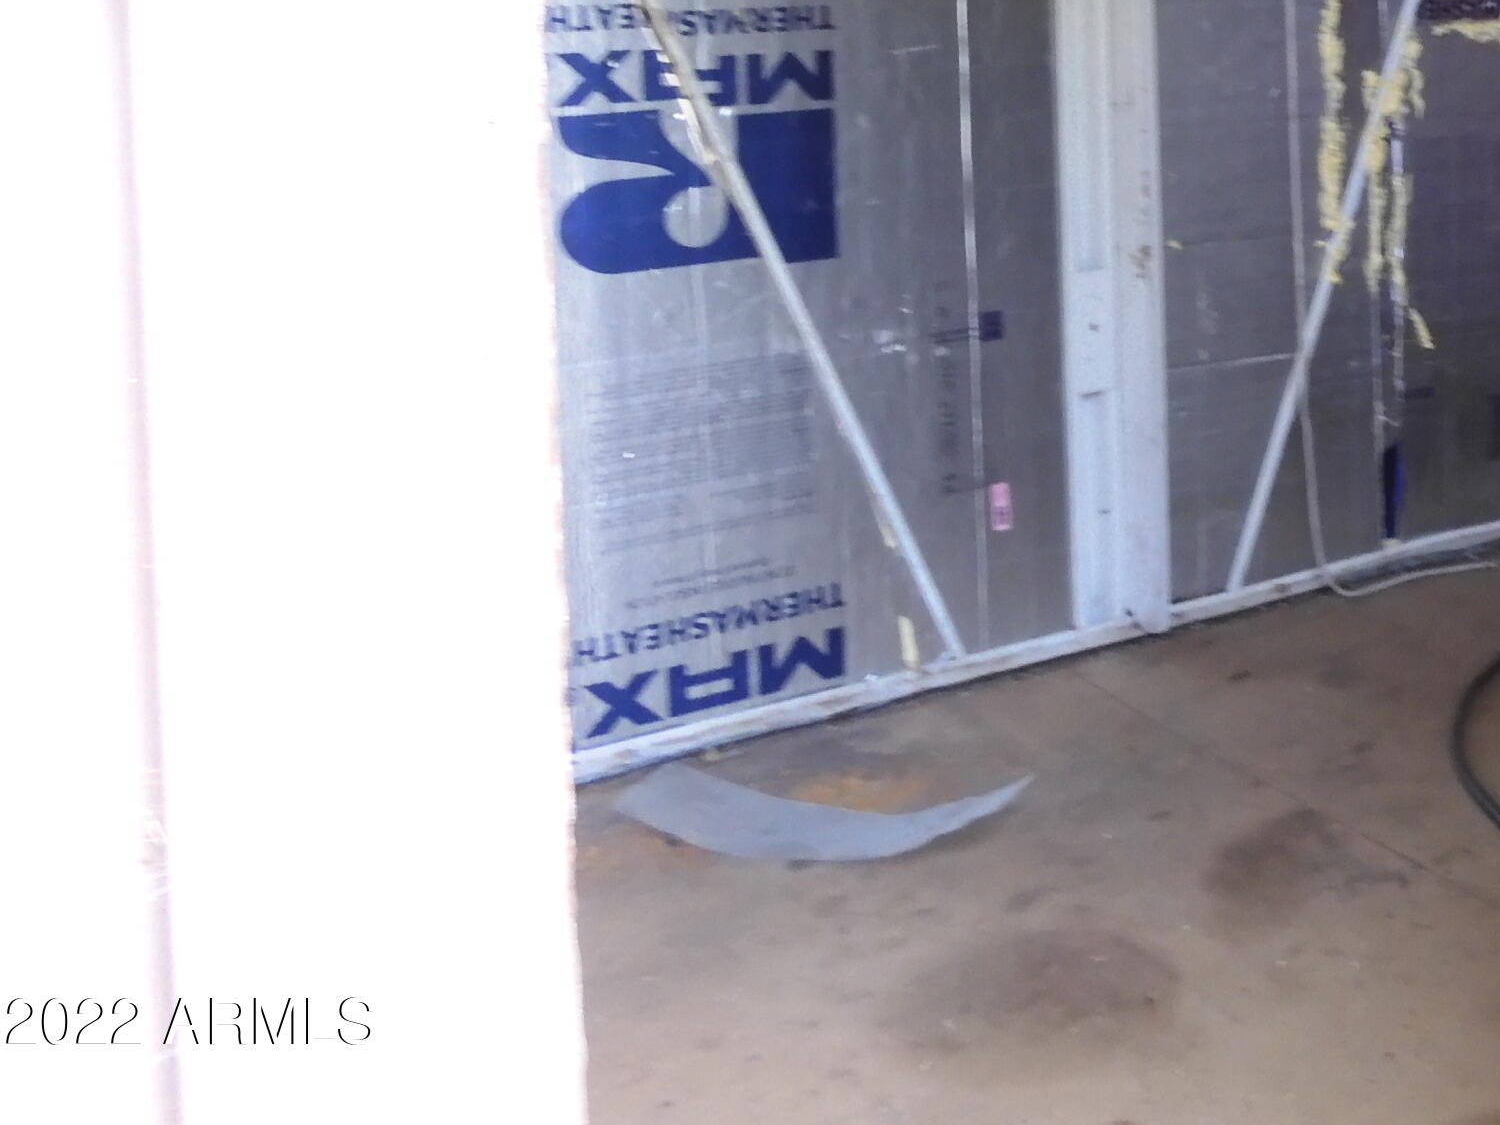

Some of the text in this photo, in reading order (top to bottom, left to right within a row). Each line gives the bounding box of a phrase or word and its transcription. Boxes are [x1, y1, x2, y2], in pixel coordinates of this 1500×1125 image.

[545, 4, 836, 36] THERMASEATH
[556, 50, 835, 107] MAX
[584, 626, 846, 739] MAX
